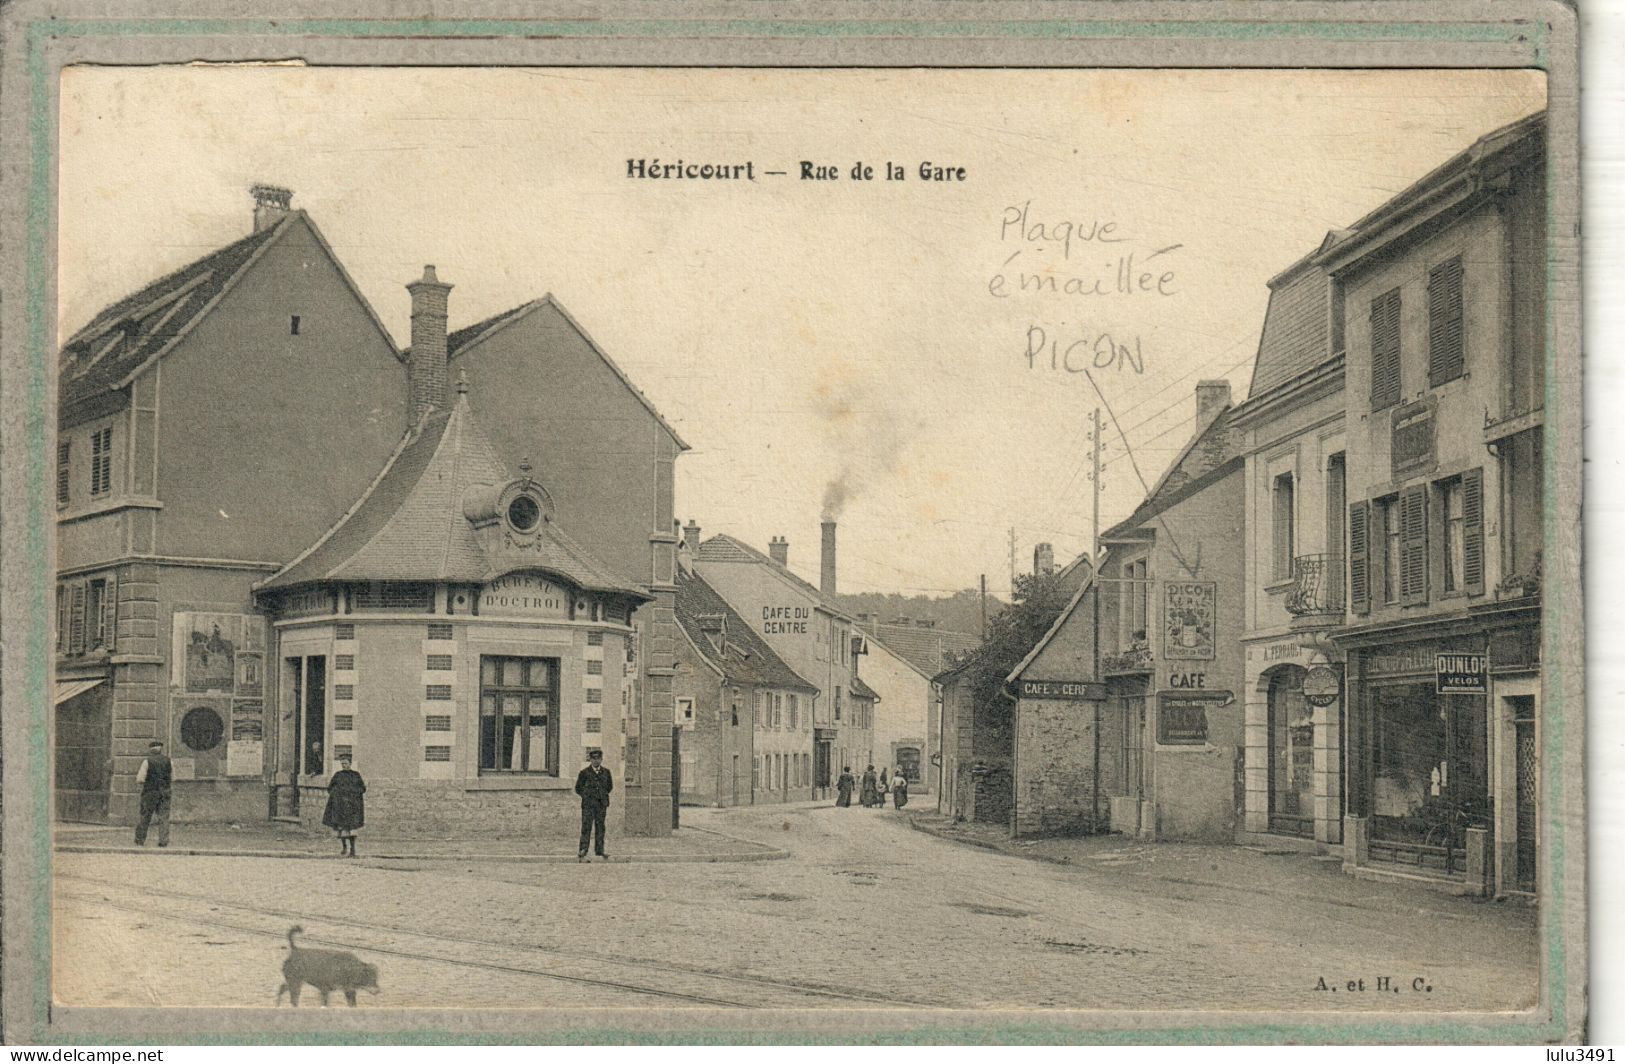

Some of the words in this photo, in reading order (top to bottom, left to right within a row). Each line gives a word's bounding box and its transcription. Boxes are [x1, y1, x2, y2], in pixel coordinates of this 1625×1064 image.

[1001, 199, 1136, 254] Plaque
[988, 244, 1183, 299] émaillée
[1024, 325, 1145, 374] PICON
[486, 595, 559, 609] D'OCTROI
[763, 606, 791, 619] CAFE
[794, 606, 809, 619] DU
[764, 621, 808, 634] CENTRE
[1438, 655, 1487, 674] DUNLOP
[1448, 677, 1480, 685] VELOS
[1024, 682, 1050, 695] CAFE
[1062, 684, 1088, 696] CERF
